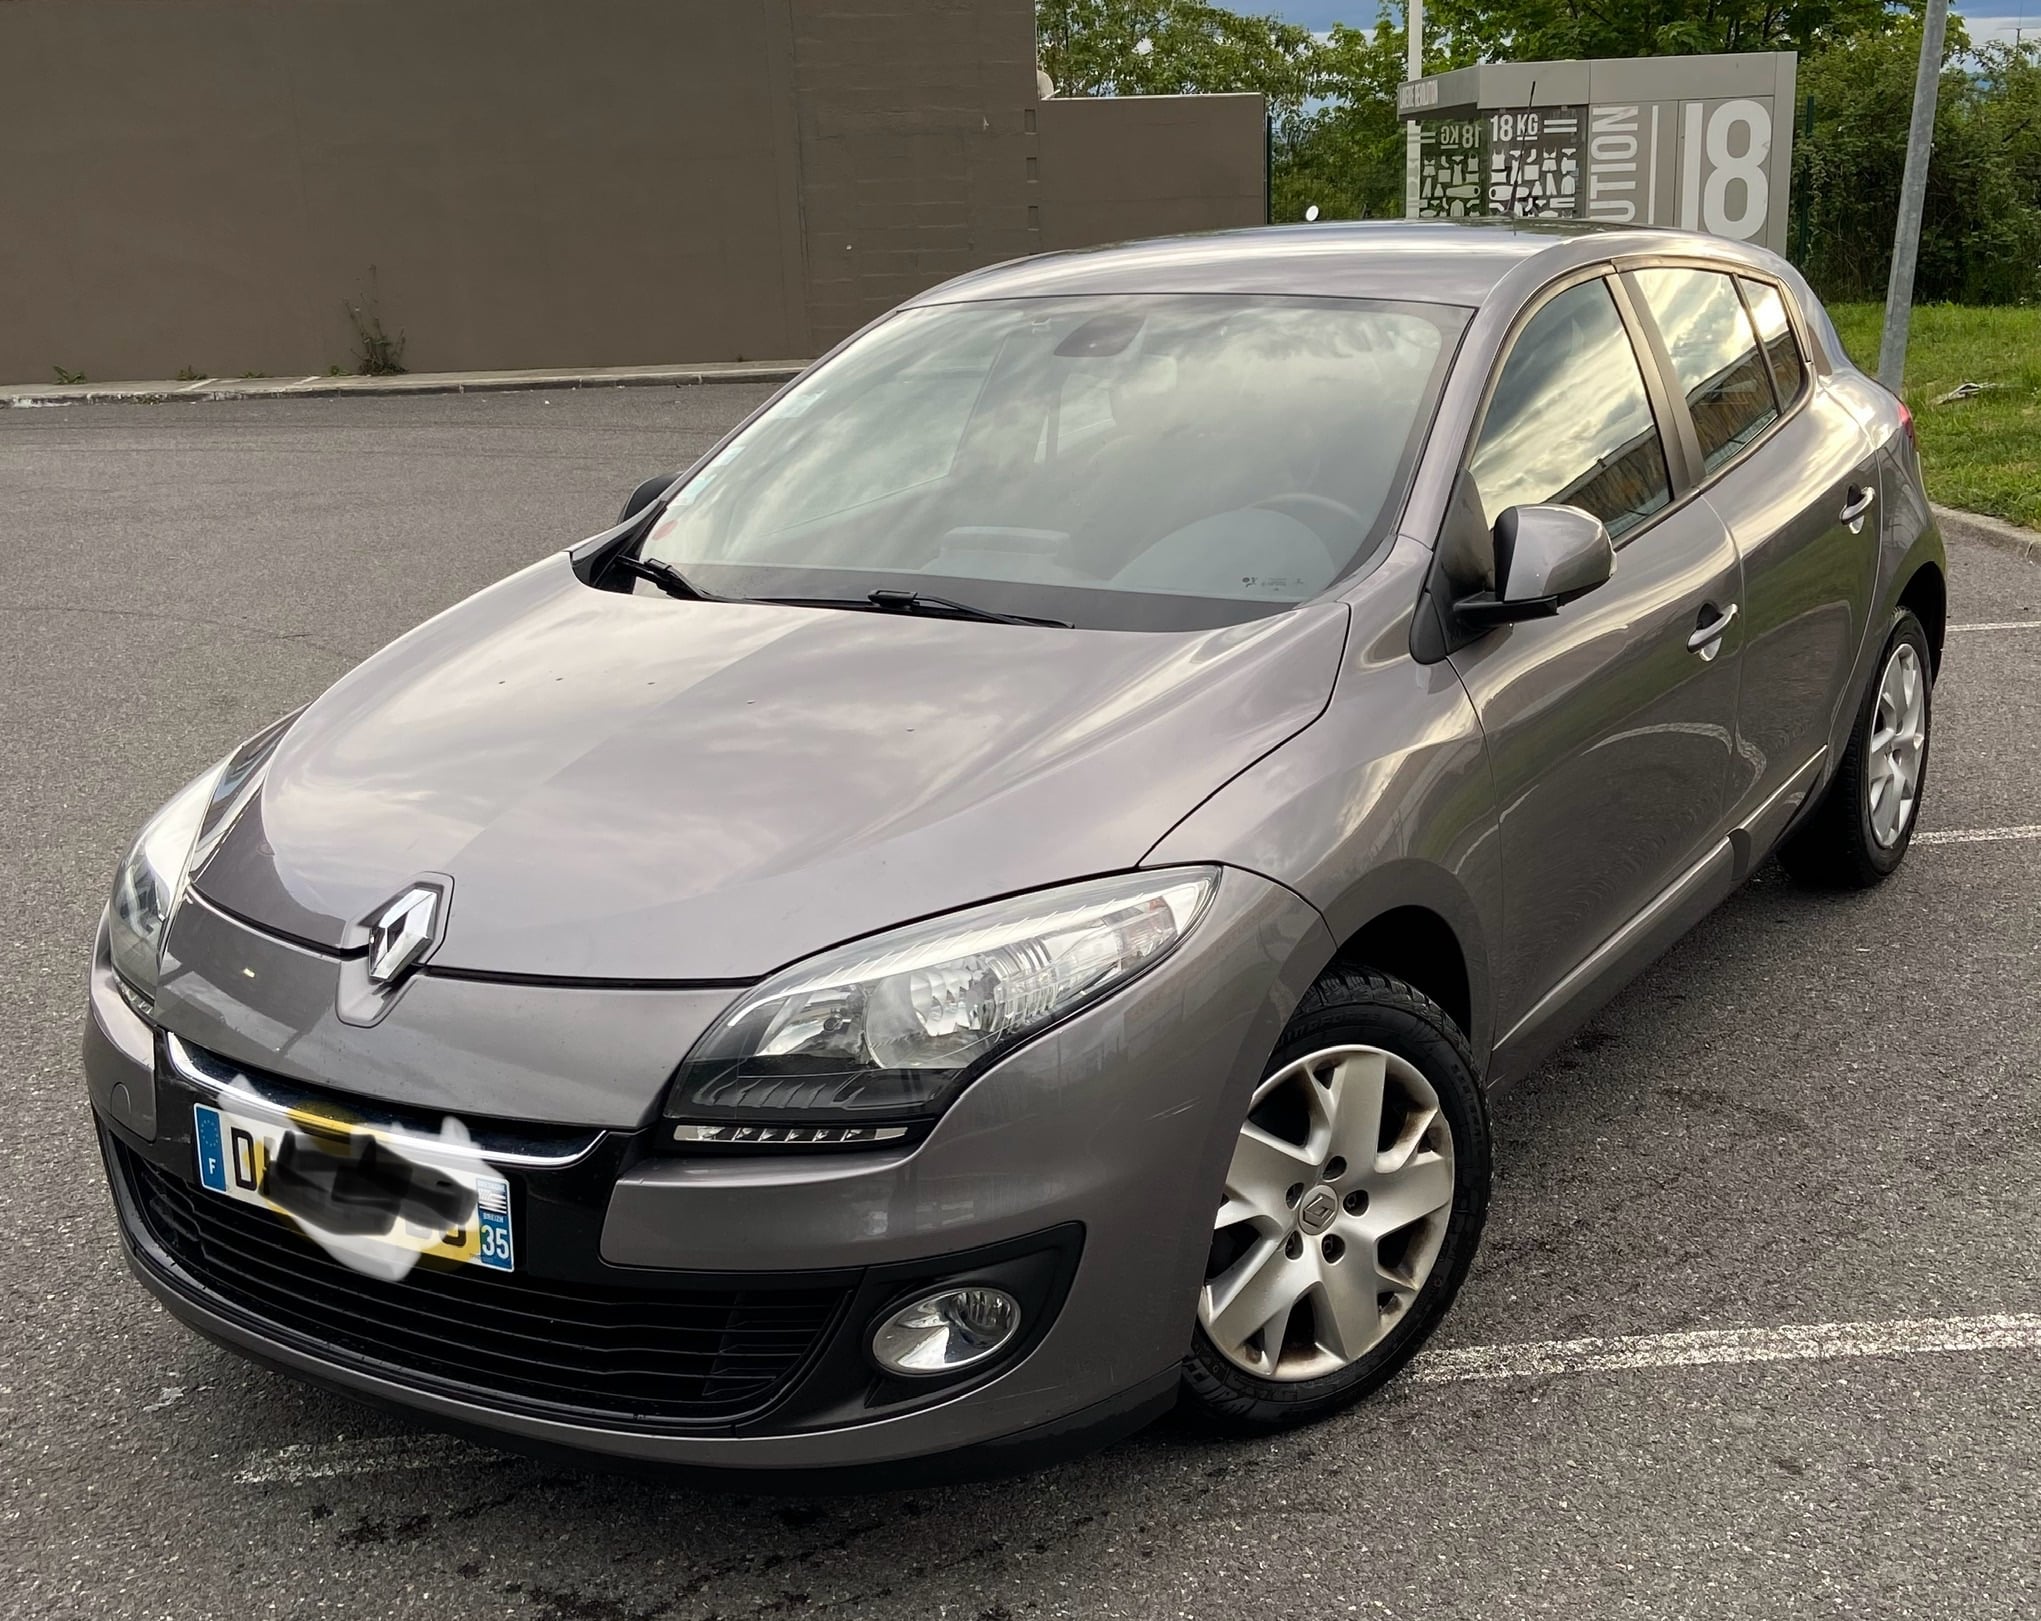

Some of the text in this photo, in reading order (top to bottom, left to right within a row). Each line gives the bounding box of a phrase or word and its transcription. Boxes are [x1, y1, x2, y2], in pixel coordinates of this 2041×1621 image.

[1490, 113, 1538, 142] 18 KG
[208, 1157, 217, 1175] F
[231, 1127, 269, 1194] D
[480, 1224, 511, 1260] 35
